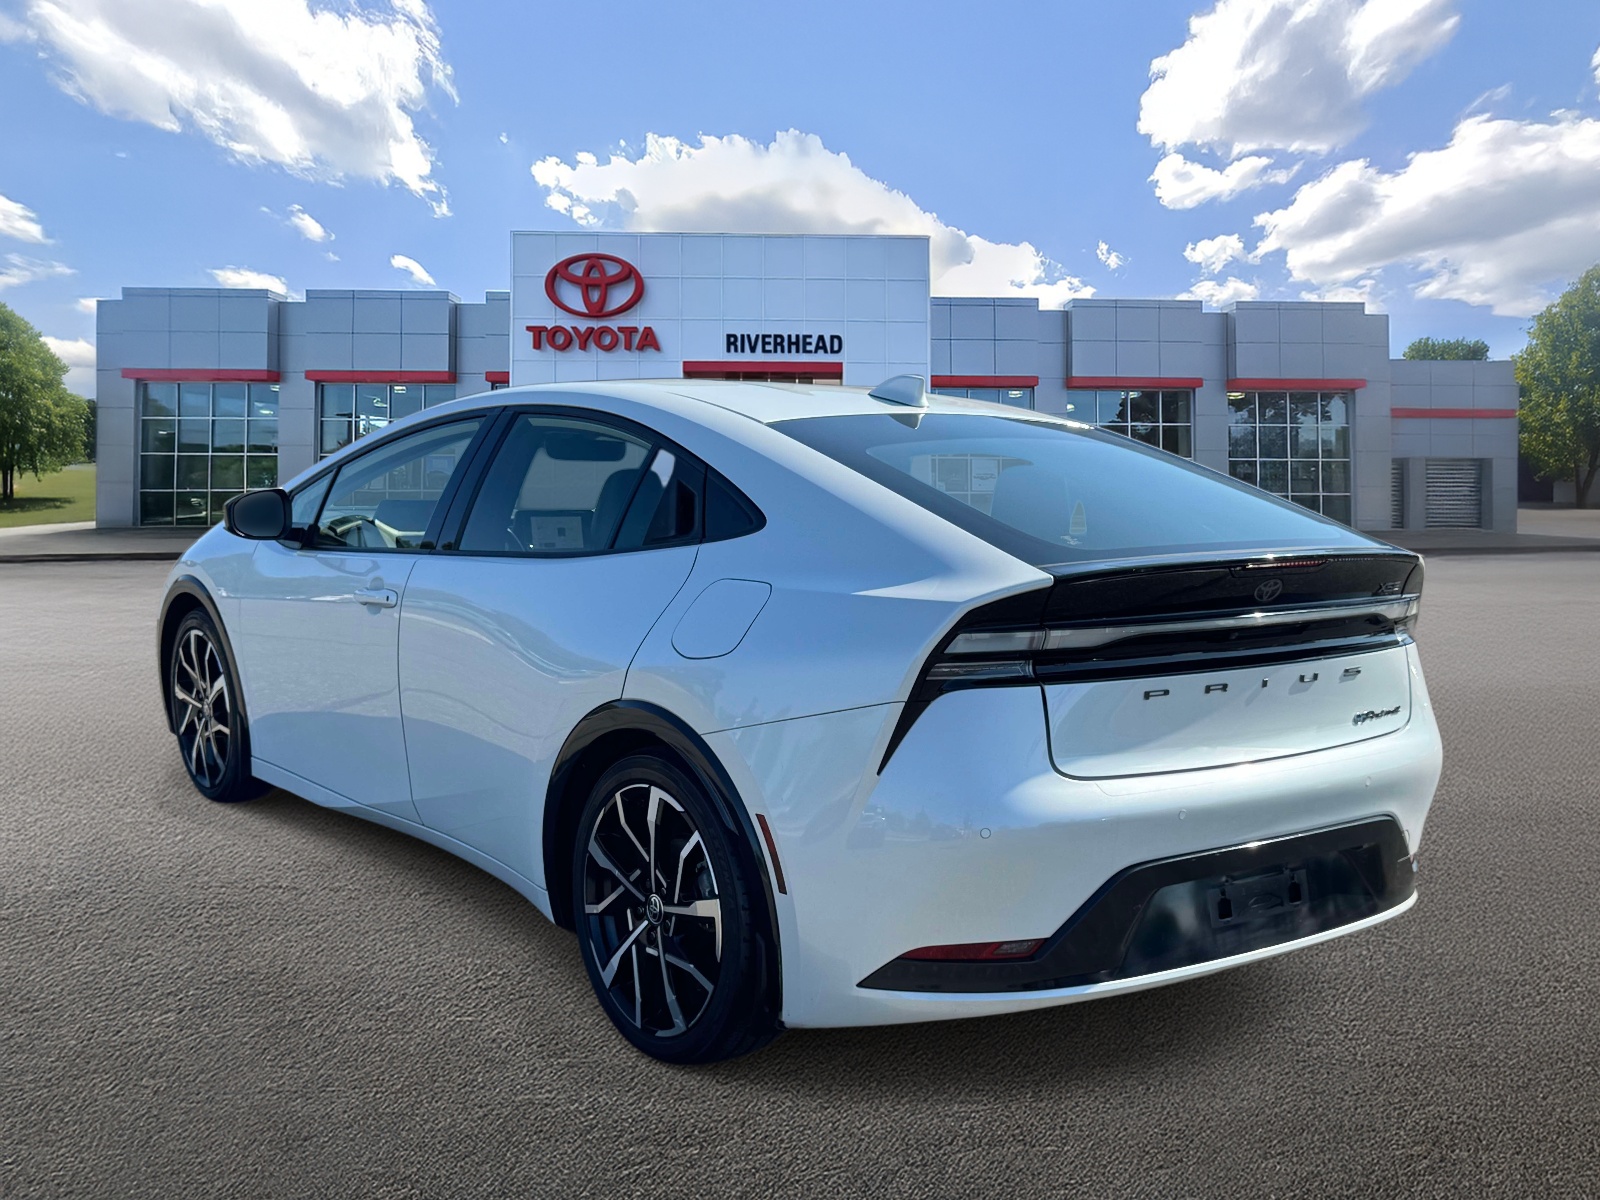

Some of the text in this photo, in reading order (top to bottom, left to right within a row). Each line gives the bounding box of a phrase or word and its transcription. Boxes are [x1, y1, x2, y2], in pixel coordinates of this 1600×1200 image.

[525, 325, 661, 352] TOYOTA
[726, 333, 843, 354] RIVERHEAD
[1143, 666, 1361, 700] PRIUS
